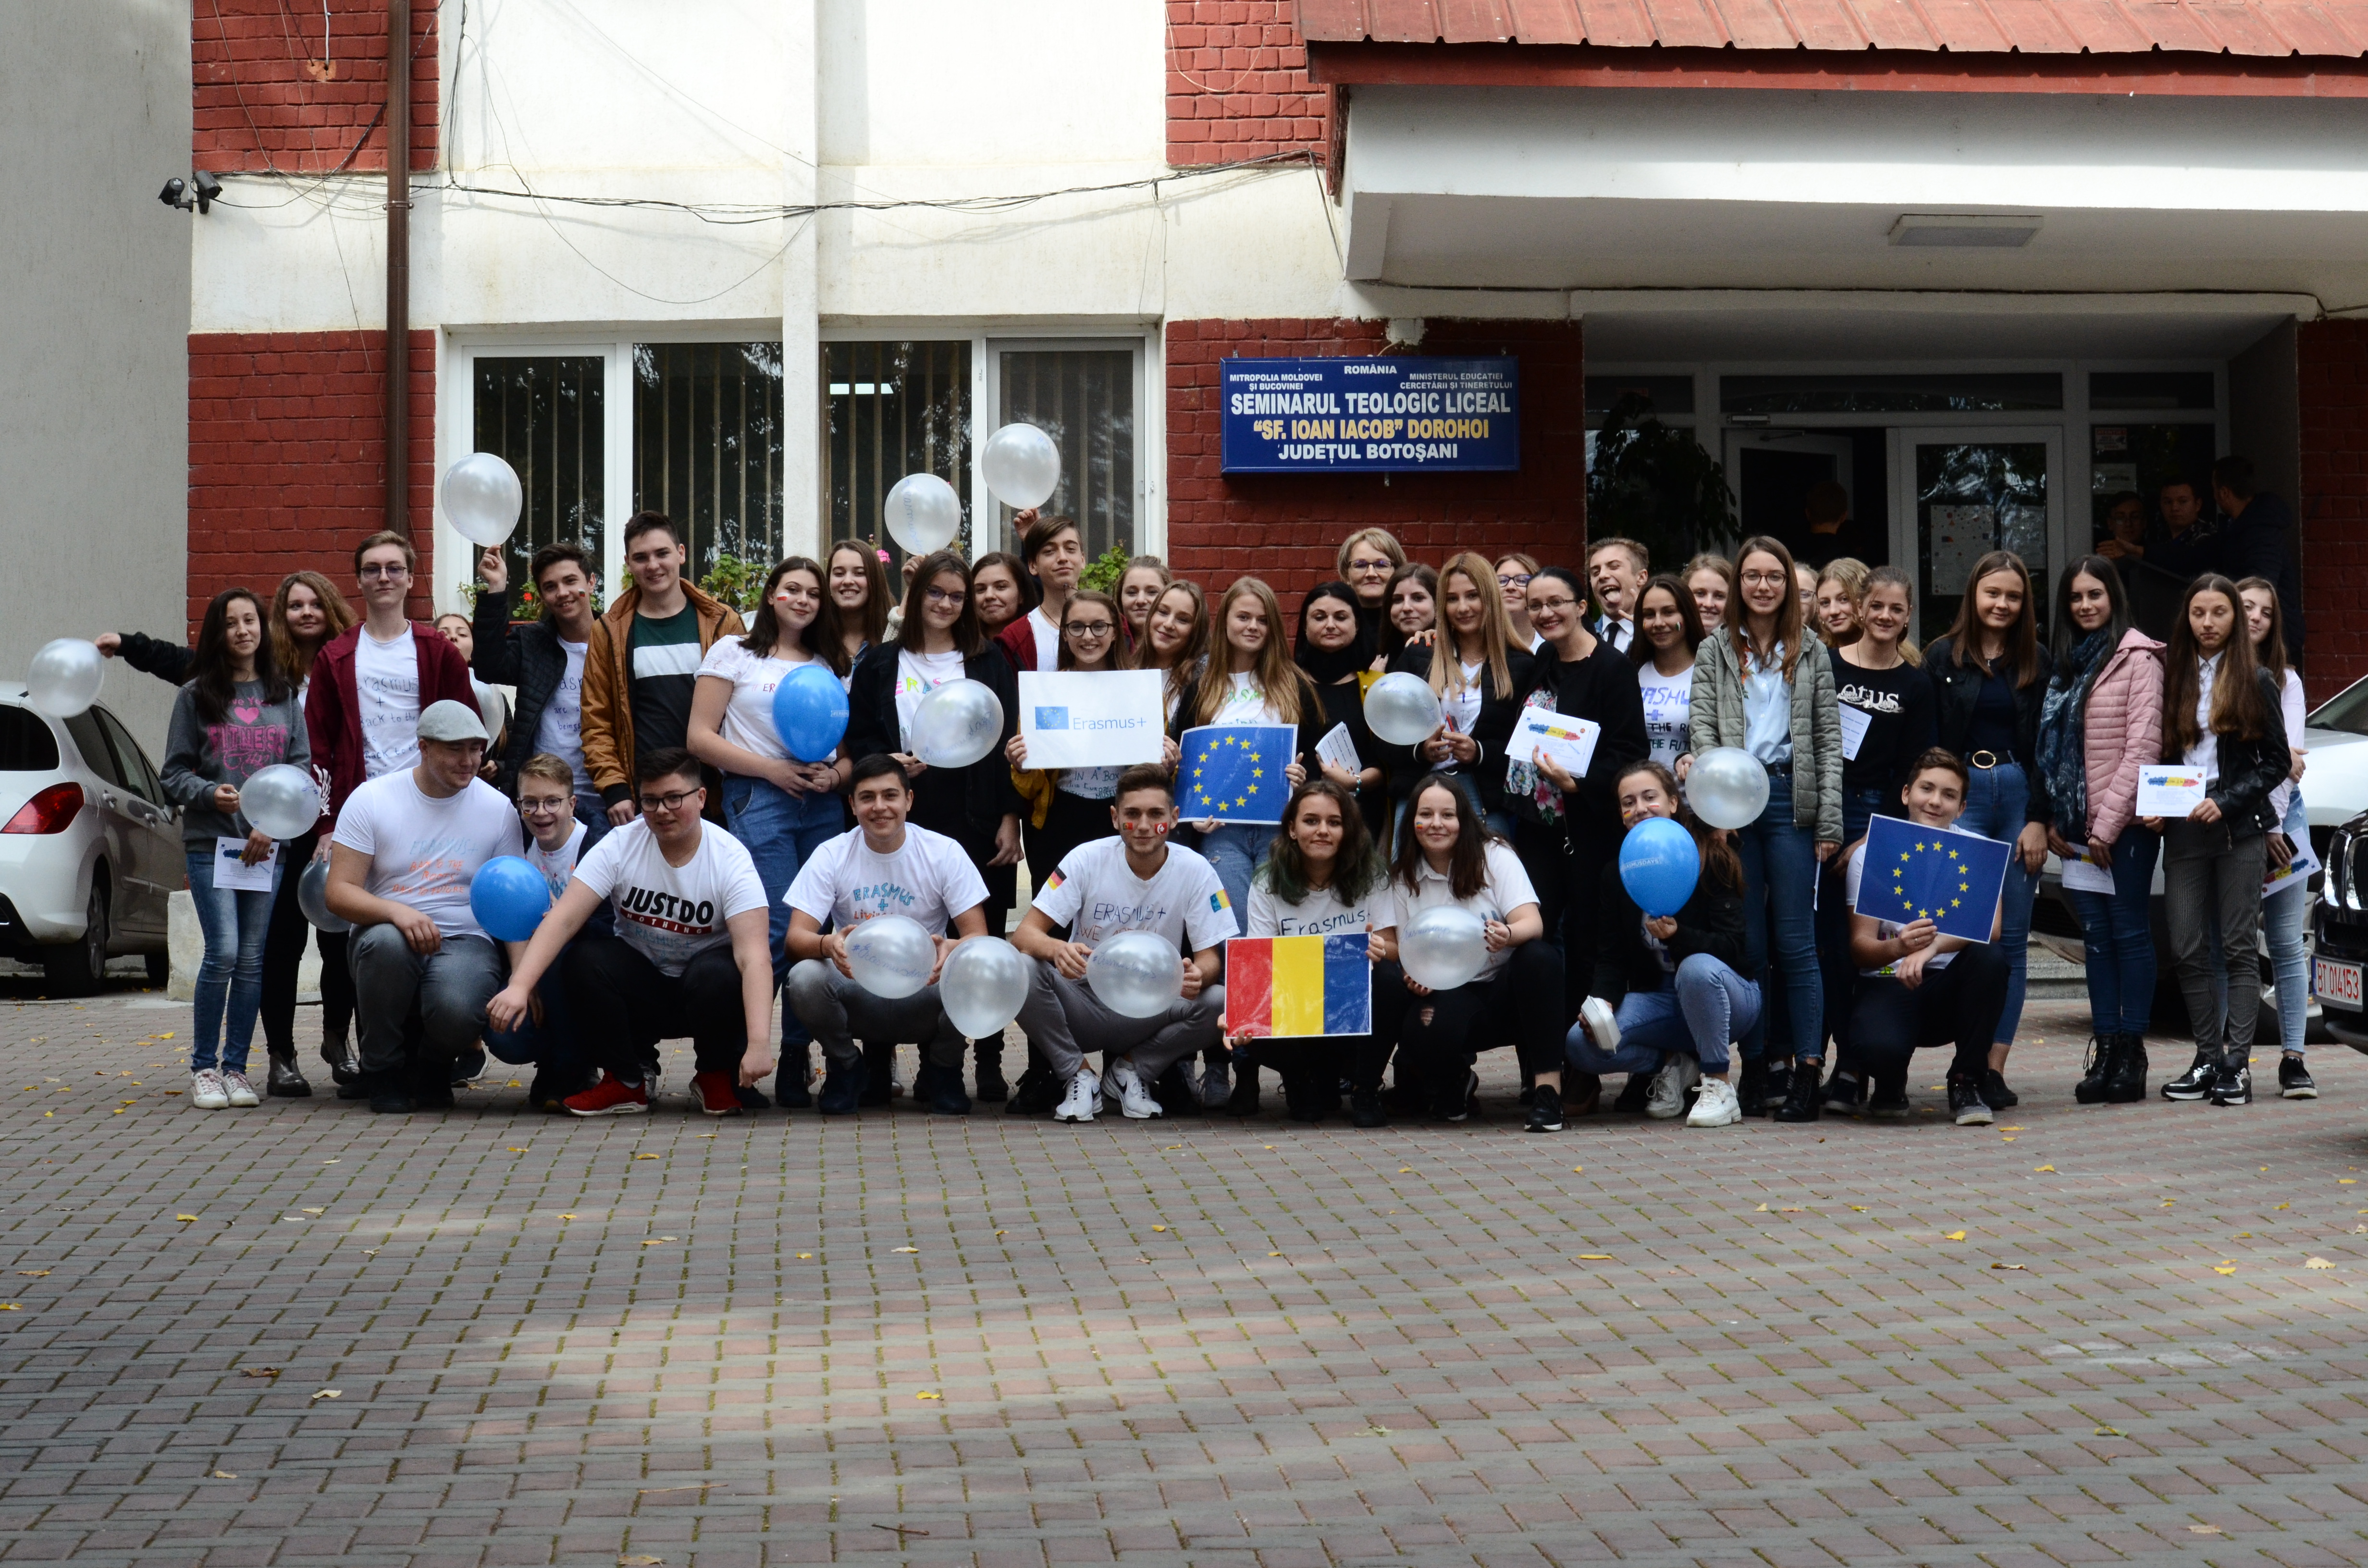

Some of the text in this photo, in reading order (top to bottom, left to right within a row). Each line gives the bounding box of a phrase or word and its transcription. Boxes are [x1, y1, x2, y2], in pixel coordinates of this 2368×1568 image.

[1344, 364, 1397, 374] ROMÂNIA
[1400, 381, 1447, 390] CERCETĂRII
[1231, 392, 1511, 415] SEMINARUL TEOLOGIC LICEAL
[1292, 419, 1335, 440] IOAN
[1407, 419, 1489, 439] DOROHOI
[357, 676, 419, 692] rasmus
[895, 676, 941, 695] ERAS
[1073, 717, 1147, 730] Erasmus+
[1647, 723, 1672, 732] THE
[1091, 769, 1098, 780] A
[853, 882, 915, 906] ERASMUS
[621, 886, 714, 925] JUST DO
[627, 913, 703, 934] NOTHING
[1081, 924, 1102, 942] WE
[2318, 962, 2359, 1000] BT 014153
